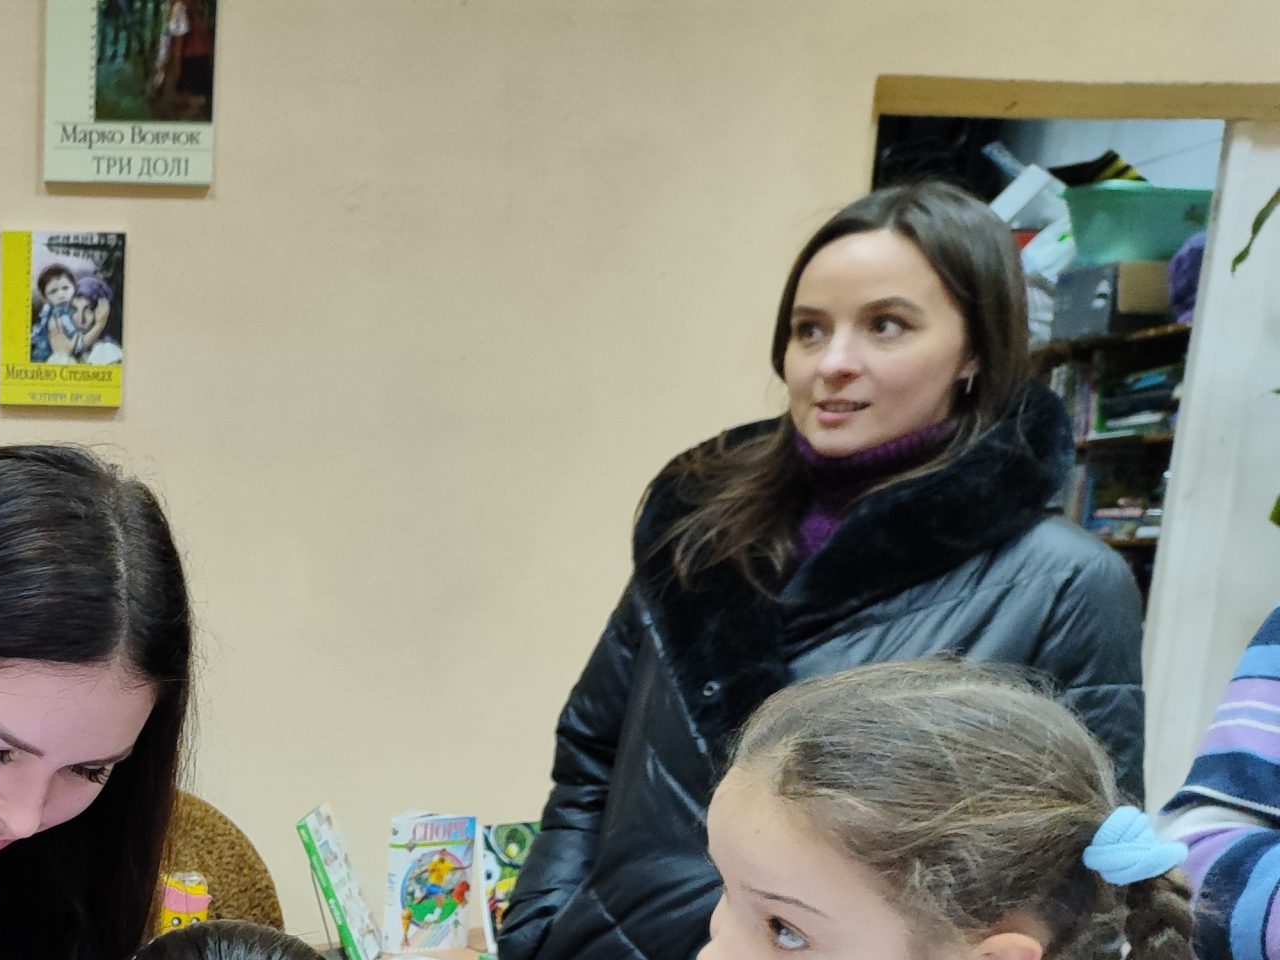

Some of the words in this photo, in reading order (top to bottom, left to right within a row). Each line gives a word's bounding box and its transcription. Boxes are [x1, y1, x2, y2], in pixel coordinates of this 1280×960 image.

[60, 123, 125, 149] Марко
[131, 125, 201, 144] Вовчок
[93, 156, 132, 175] ТРИ
[138, 157, 190, 177] ДОЛІ
